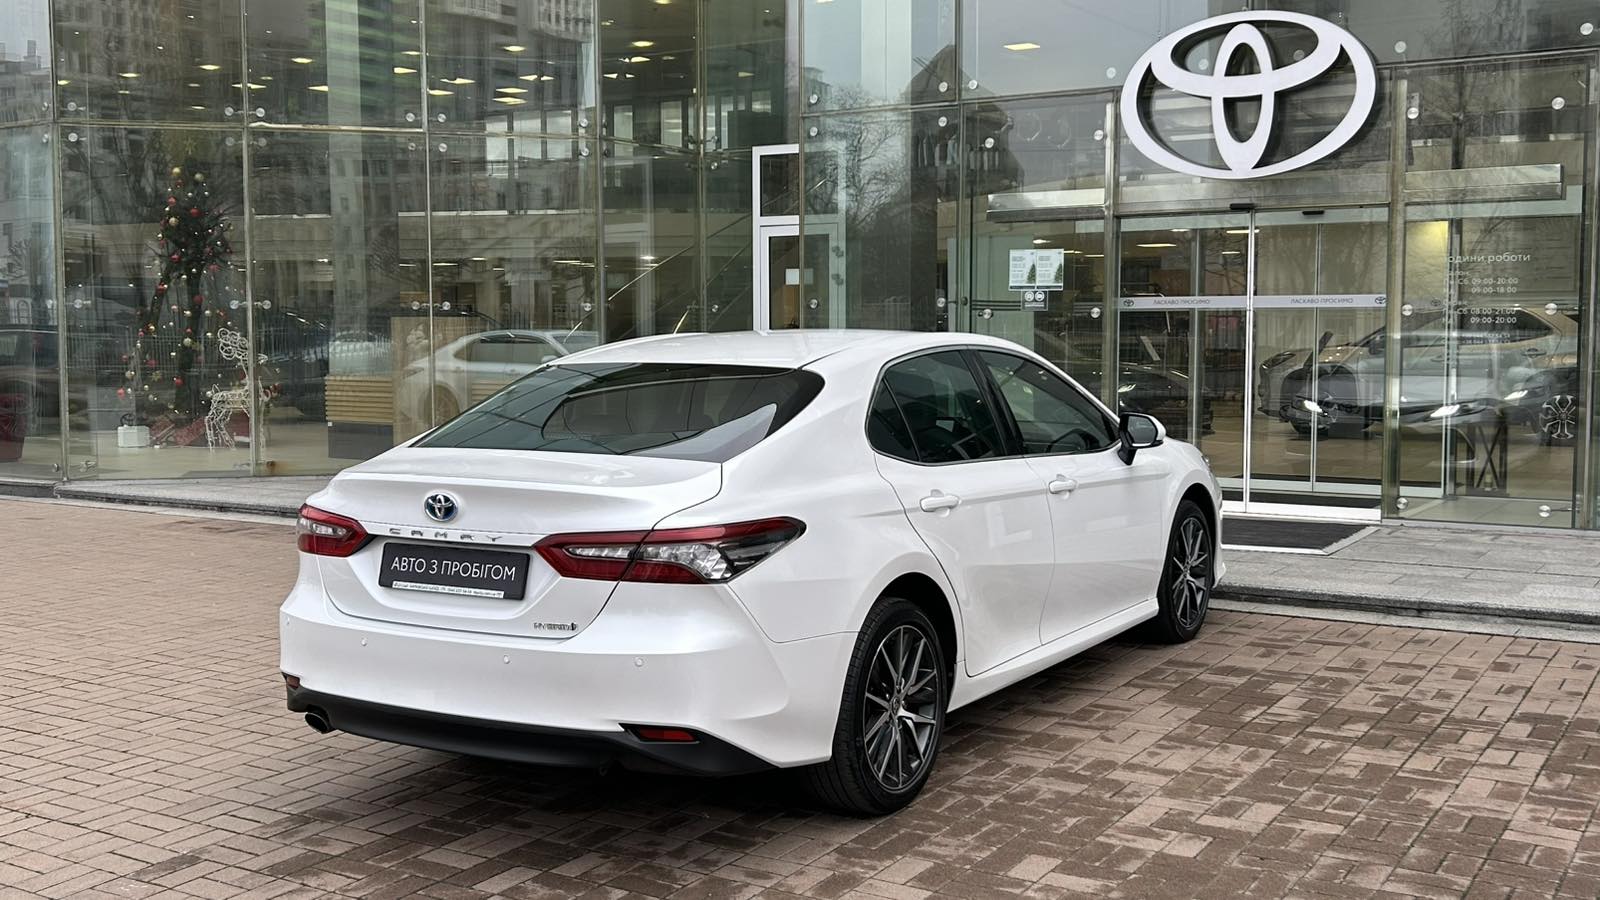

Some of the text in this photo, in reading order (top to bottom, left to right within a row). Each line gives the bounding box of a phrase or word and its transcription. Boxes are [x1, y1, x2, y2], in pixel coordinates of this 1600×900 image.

[1488, 251, 1531, 265] роботи
[389, 527, 503, 542] CAMRY
[390, 556, 427, 574] АВТО
[440, 560, 516, 582] ПРОБІГОМ
